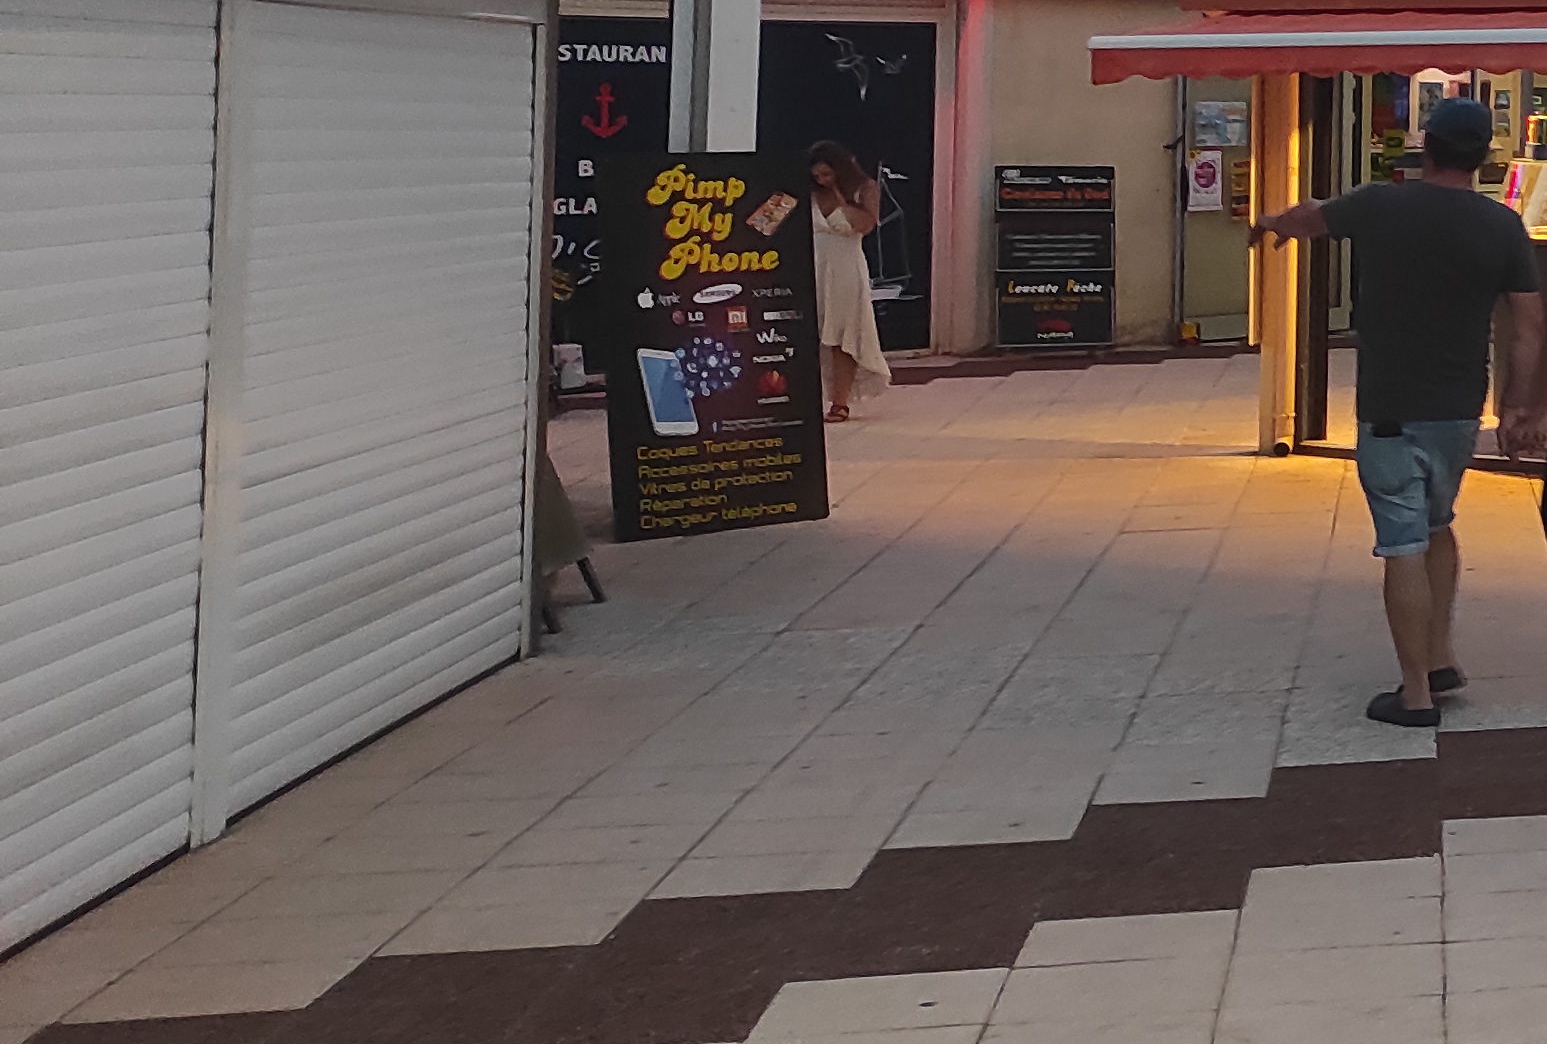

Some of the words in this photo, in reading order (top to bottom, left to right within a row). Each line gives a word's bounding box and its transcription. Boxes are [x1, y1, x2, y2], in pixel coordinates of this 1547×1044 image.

[646, 164, 746, 206] Pimp
[665, 201, 733, 241] My
[659, 236, 780, 280] Phone
[636, 445, 698, 460] Coques
[703, 437, 783, 453] Tendances
[638, 459, 738, 479] Accessoires
[743, 453, 802, 467] mobiles
[691, 478, 710, 491] de
[715, 470, 794, 491] protection
[640, 511, 718, 530] Chargeur
